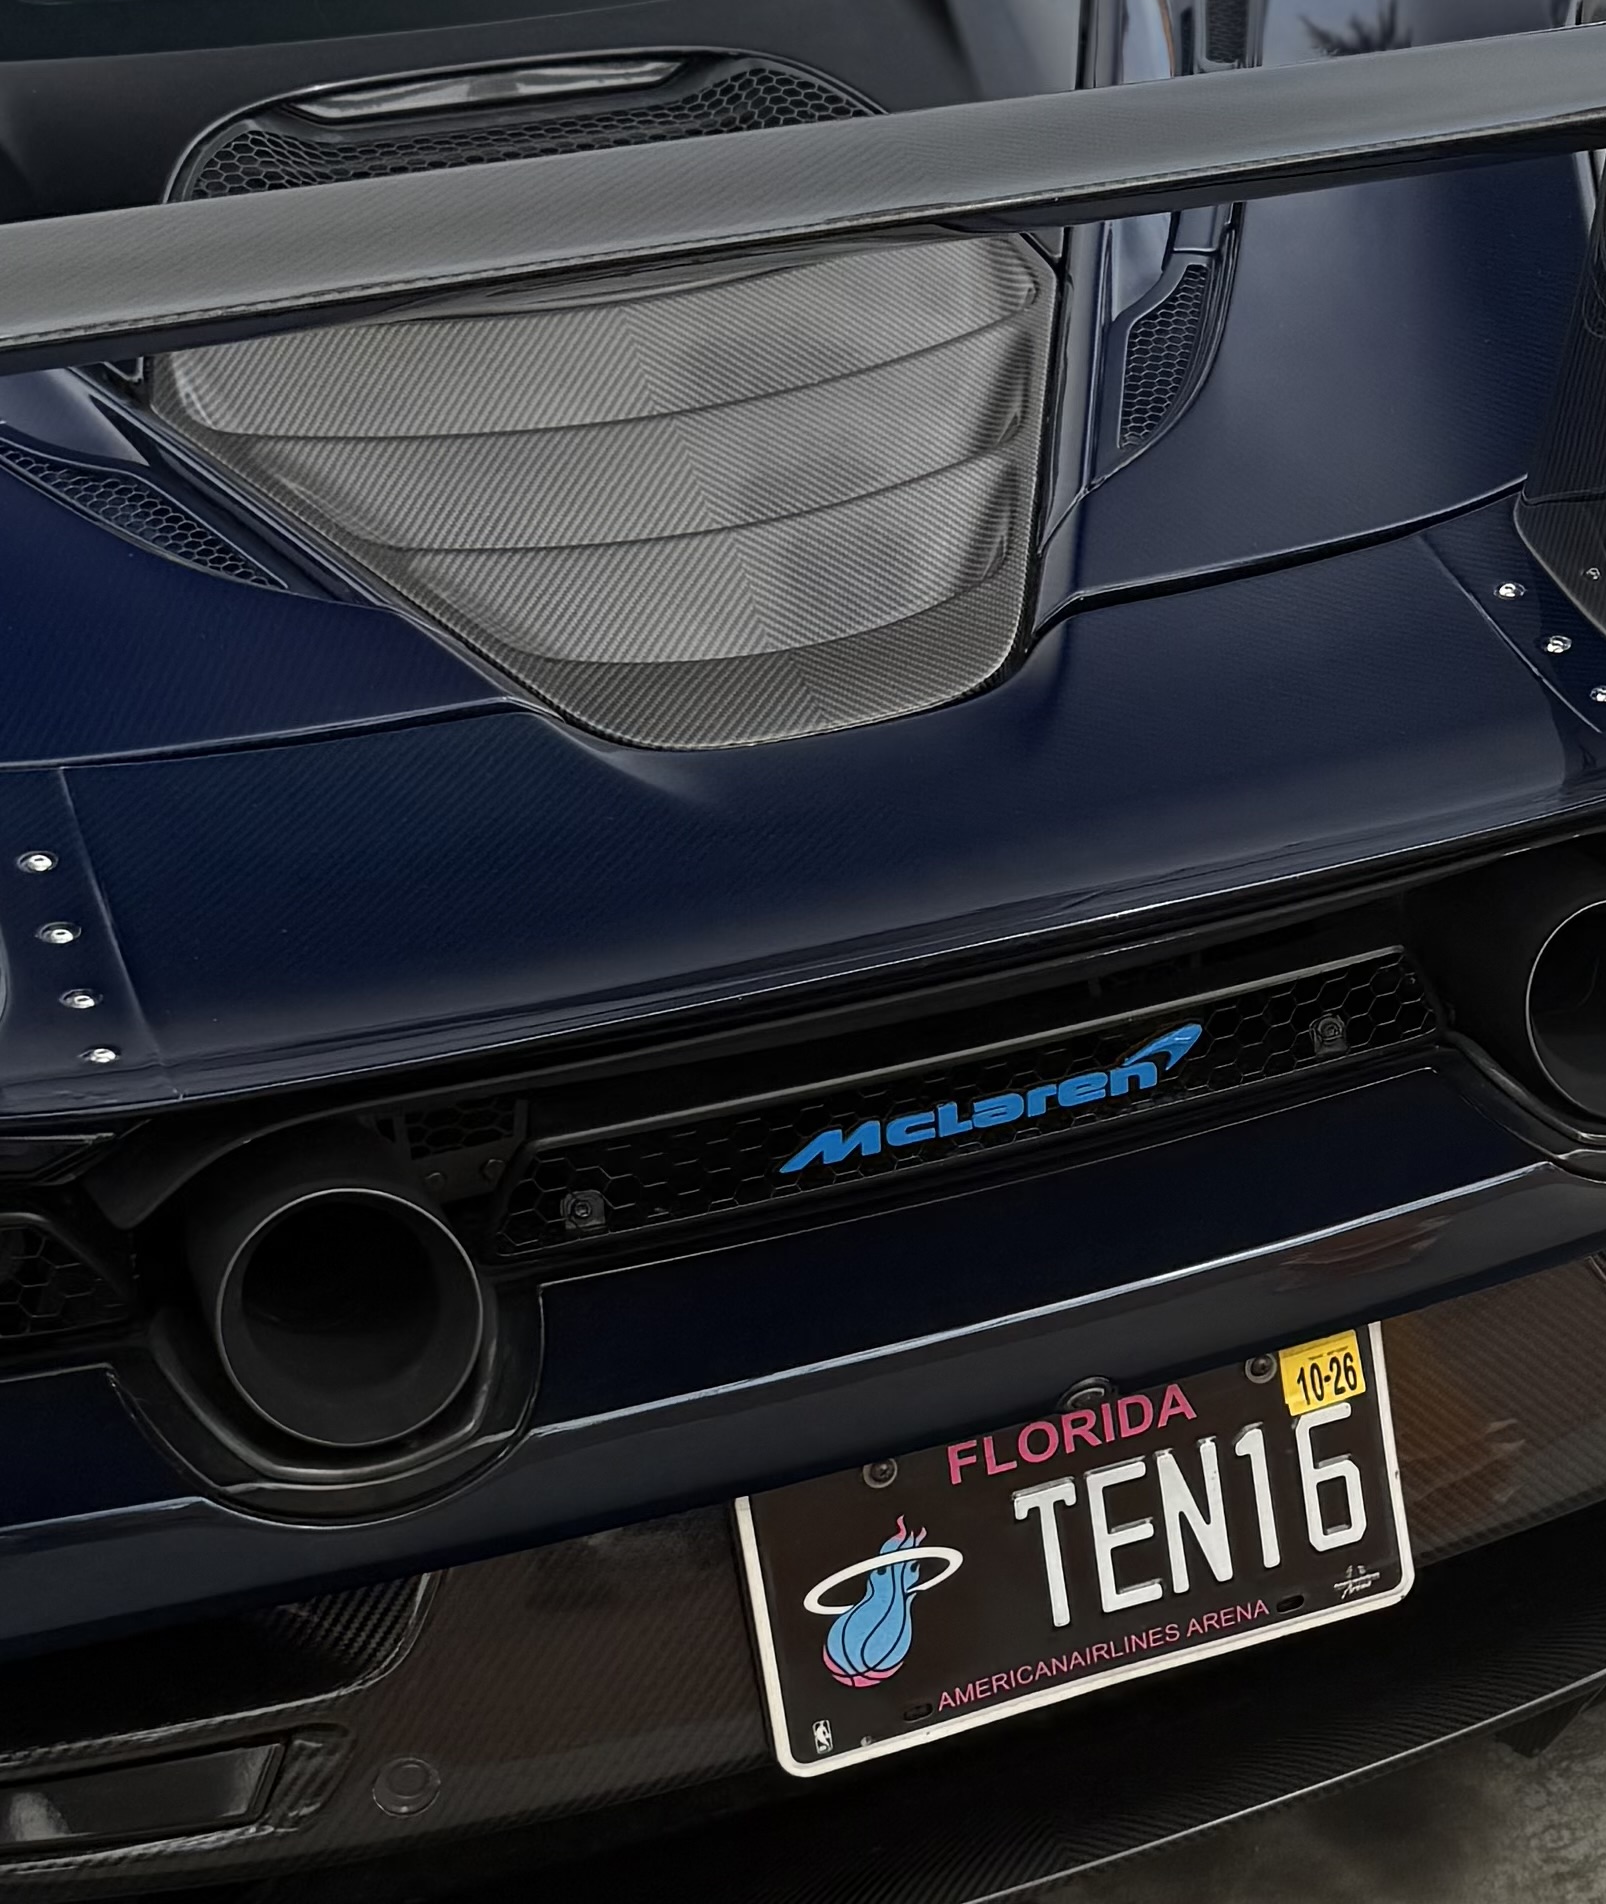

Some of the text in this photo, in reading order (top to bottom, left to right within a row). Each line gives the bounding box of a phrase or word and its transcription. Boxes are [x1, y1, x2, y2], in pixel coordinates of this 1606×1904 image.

[779, 1061, 1159, 1173] McLaren
[1296, 1352, 1357, 1405] 10-26
[946, 1384, 1196, 1485] FLORIDA
[1012, 1402, 1367, 1627] TEN16
[938, 1600, 1270, 1711] AMERICANAIRLINES ARENA
